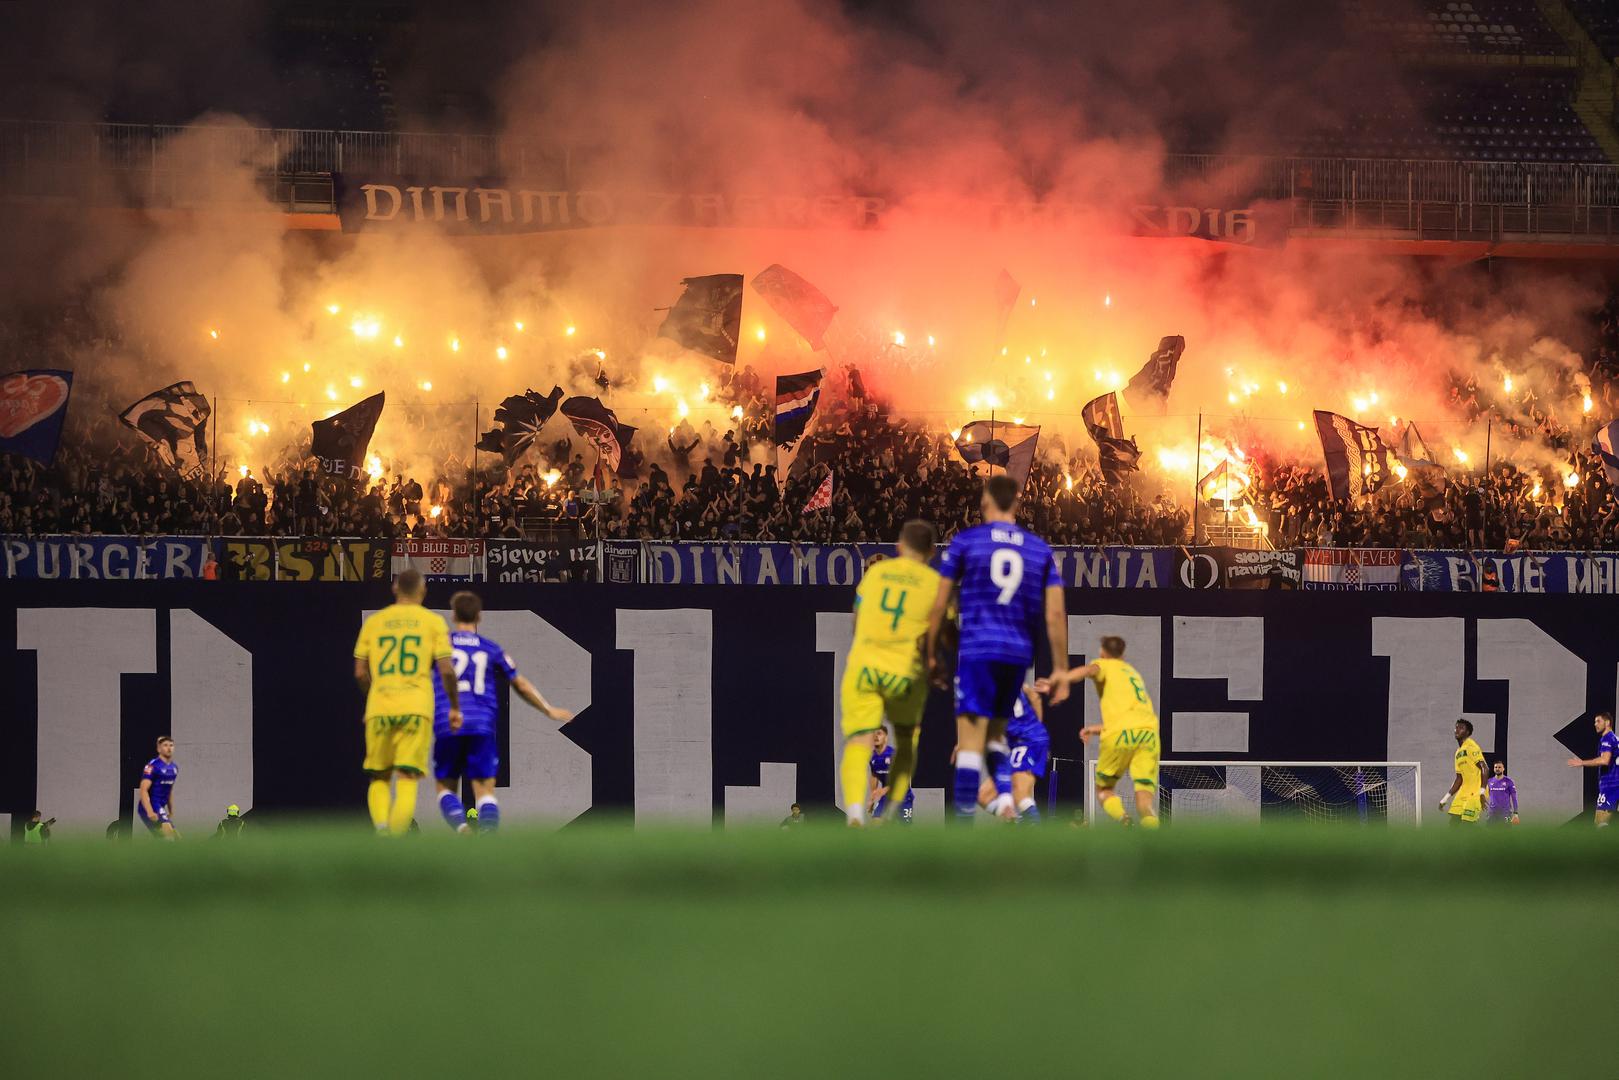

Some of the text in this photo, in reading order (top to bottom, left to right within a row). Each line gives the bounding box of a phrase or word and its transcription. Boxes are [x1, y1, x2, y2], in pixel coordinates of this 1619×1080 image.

[360, 184, 614, 223] DINAMO
[422, 543, 449, 553] BLUE
[604, 543, 638, 555] dinamo
[651, 547, 853, 585] DINAMO
[991, 549, 1024, 605] 9
[1565, 556, 1619, 594] MA
[880, 588, 906, 632] 4
[378, 635, 421, 676] 26
[450, 649, 488, 695] 21
